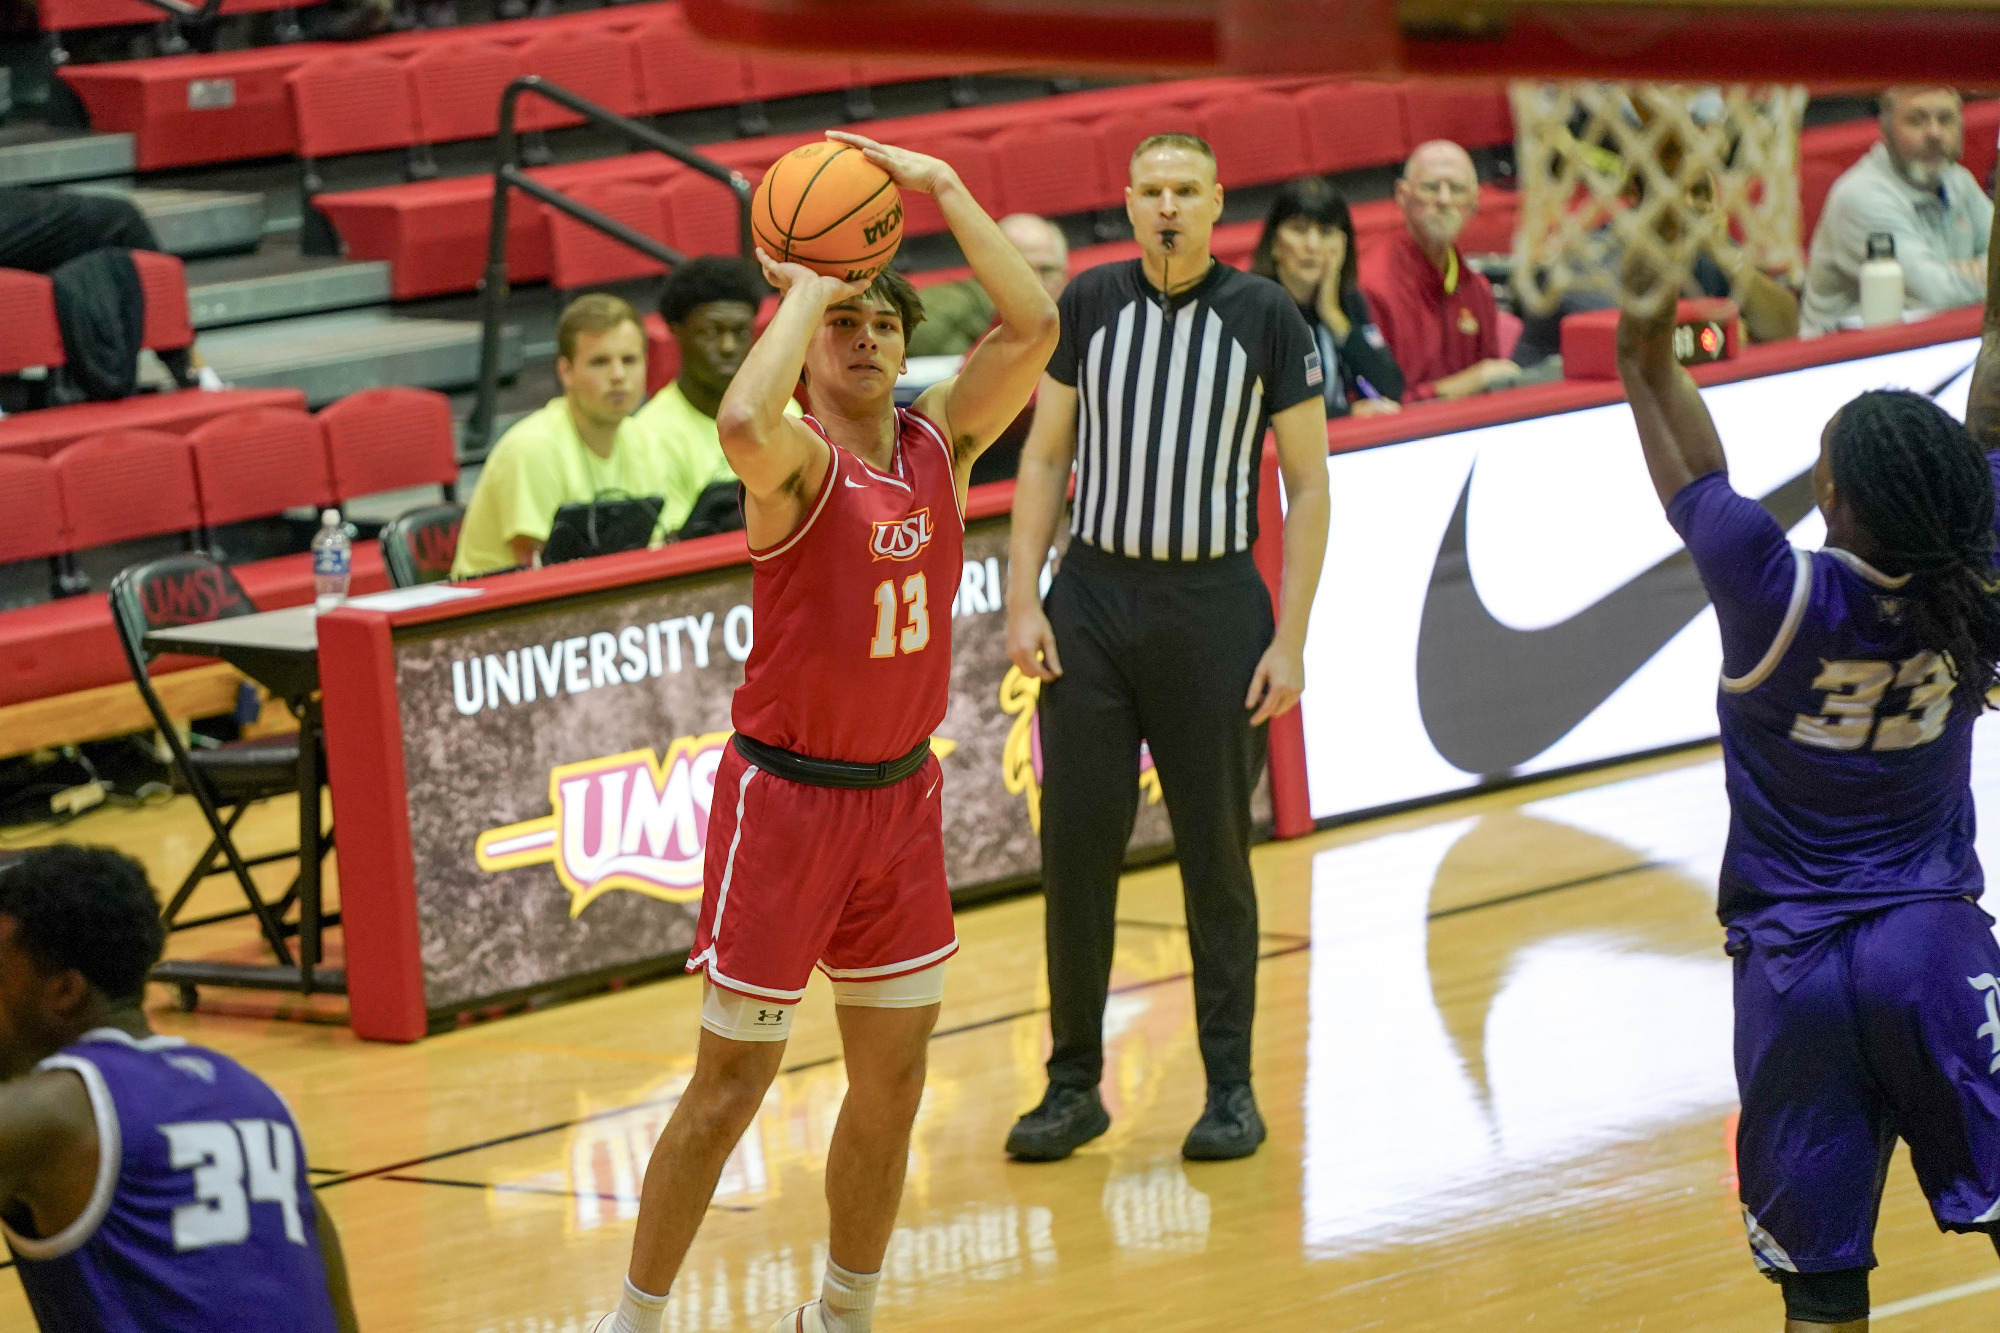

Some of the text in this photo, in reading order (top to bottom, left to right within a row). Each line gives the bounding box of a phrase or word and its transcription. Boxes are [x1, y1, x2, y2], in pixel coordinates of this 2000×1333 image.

[863, 197, 902, 246] NCAA
[452, 612, 714, 715] UNIVERSITY
[723, 604, 753, 662] O
[951, 556, 1001, 619] RI
[870, 571, 930, 658] 13
[1790, 650, 1958, 750] 33
[561, 749, 724, 885] UMS
[156, 1118, 307, 1252] 34
